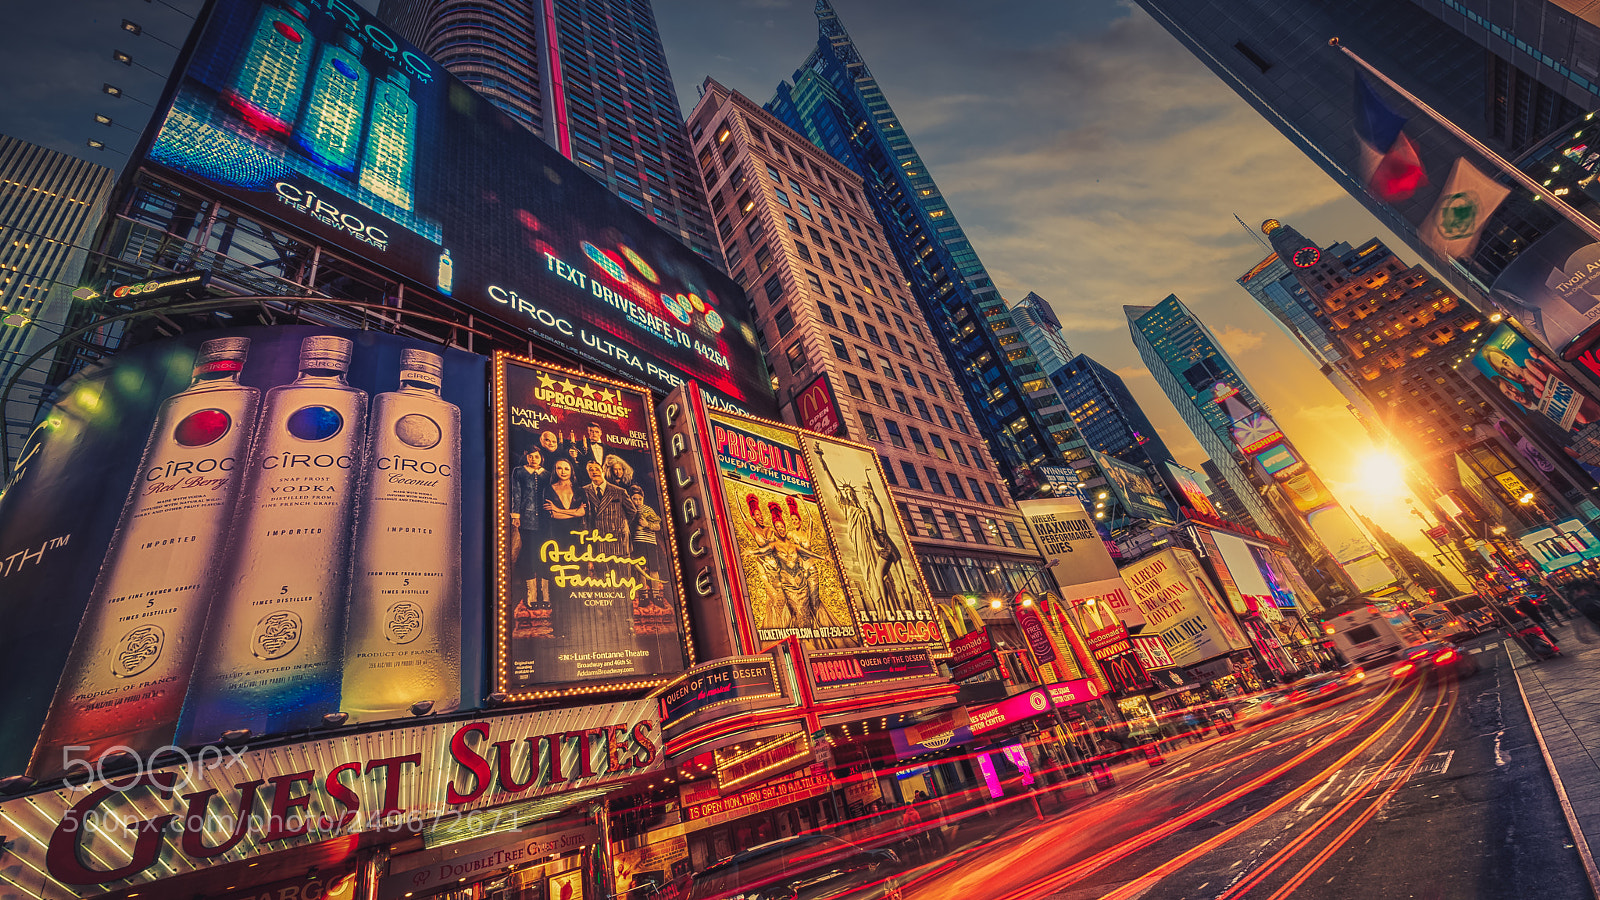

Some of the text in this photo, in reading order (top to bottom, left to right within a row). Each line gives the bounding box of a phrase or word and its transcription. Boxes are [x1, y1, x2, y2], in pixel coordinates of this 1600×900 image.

[327, 0, 432, 79] ROC
[276, 194, 307, 214] THE
[311, 210, 343, 231] NEW
[1555, 271, 1586, 293] Tivoli
[544, 252, 730, 371] TEXT DRIVESAFE TO 44264
[581, 329, 643, 371] ULTRA
[1552, 381, 1573, 407] PASS
[511, 406, 558, 424] NATHAN
[511, 415, 540, 430] LANE
[809, 406, 829, 426] OPEN
[606, 434, 649, 448] NEUWIRTH
[629, 430, 647, 440] BEBE
[1244, 431, 1284, 453] TOSHIBA
[714, 425, 809, 481] PRISCILLA
[388, 472, 439, 488] Coconut
[718, 454, 811, 489] QUEEN OF THE DESERT
[142, 476, 229, 496] Red Berry
[270, 485, 336, 494] VODKA
[666, 402, 714, 597] PALACE
[1029, 513, 1057, 524] WHERE
[267, 528, 322, 537] IMPORTED
[387, 526, 433, 535] IMPORTED
[1034, 519, 1090, 536] MAXIMUM
[141, 535, 196, 550] IMPORTED
[570, 529, 617, 544] The
[1040, 530, 1095, 545] PERFORMANCE
[540, 540, 646, 566] Addams
[1044, 541, 1074, 556] LIVES
[1130, 557, 1168, 587] ALREADY
[280, 585, 289, 595] 5
[403, 578, 410, 587] 5
[550, 565, 643, 600] Family
[1134, 577, 1162, 600] KNOW
[128, 592, 143, 600] FINE
[146, 588, 172, 596] FRENCH
[276, 596, 313, 604] DISTILLED
[1156, 580, 1189, 603] GONNA
[146, 598, 155, 609] 5
[1147, 605, 1173, 626] LOVE
[1168, 598, 1186, 614] IT!
[119, 607, 178, 622] TIMES DISTILLED
[888, 610, 932, 621] LARGE
[862, 621, 941, 645] CHICAGO
[1026, 624, 1040, 634] FREE
[1087, 626, 1125, 646] McDonald's
[624, 650, 650, 658] Theatre
[952, 635, 988, 656] cDonald's
[254, 665, 291, 675] BOTTLED
[577, 661, 604, 670] Broadway
[811, 658, 864, 684] PRISCILLA
[860, 657, 881, 667] QUEEN
[892, 656, 903, 664] THE
[904, 653, 926, 663] DESERT
[75, 687, 119, 701] PRODUCT
[138, 676, 179, 689] FRANCE
[666, 667, 768, 704] QUEEN OF THE DESERT
[979, 708, 1000, 720] SQUARE
[985, 714, 1006, 727] CENTER
[46, 719, 657, 885] GUEST SUITES
[689, 806, 700, 820] IS
[702, 803, 722, 816] OPEN
[560, 832, 586, 849] SUITES
